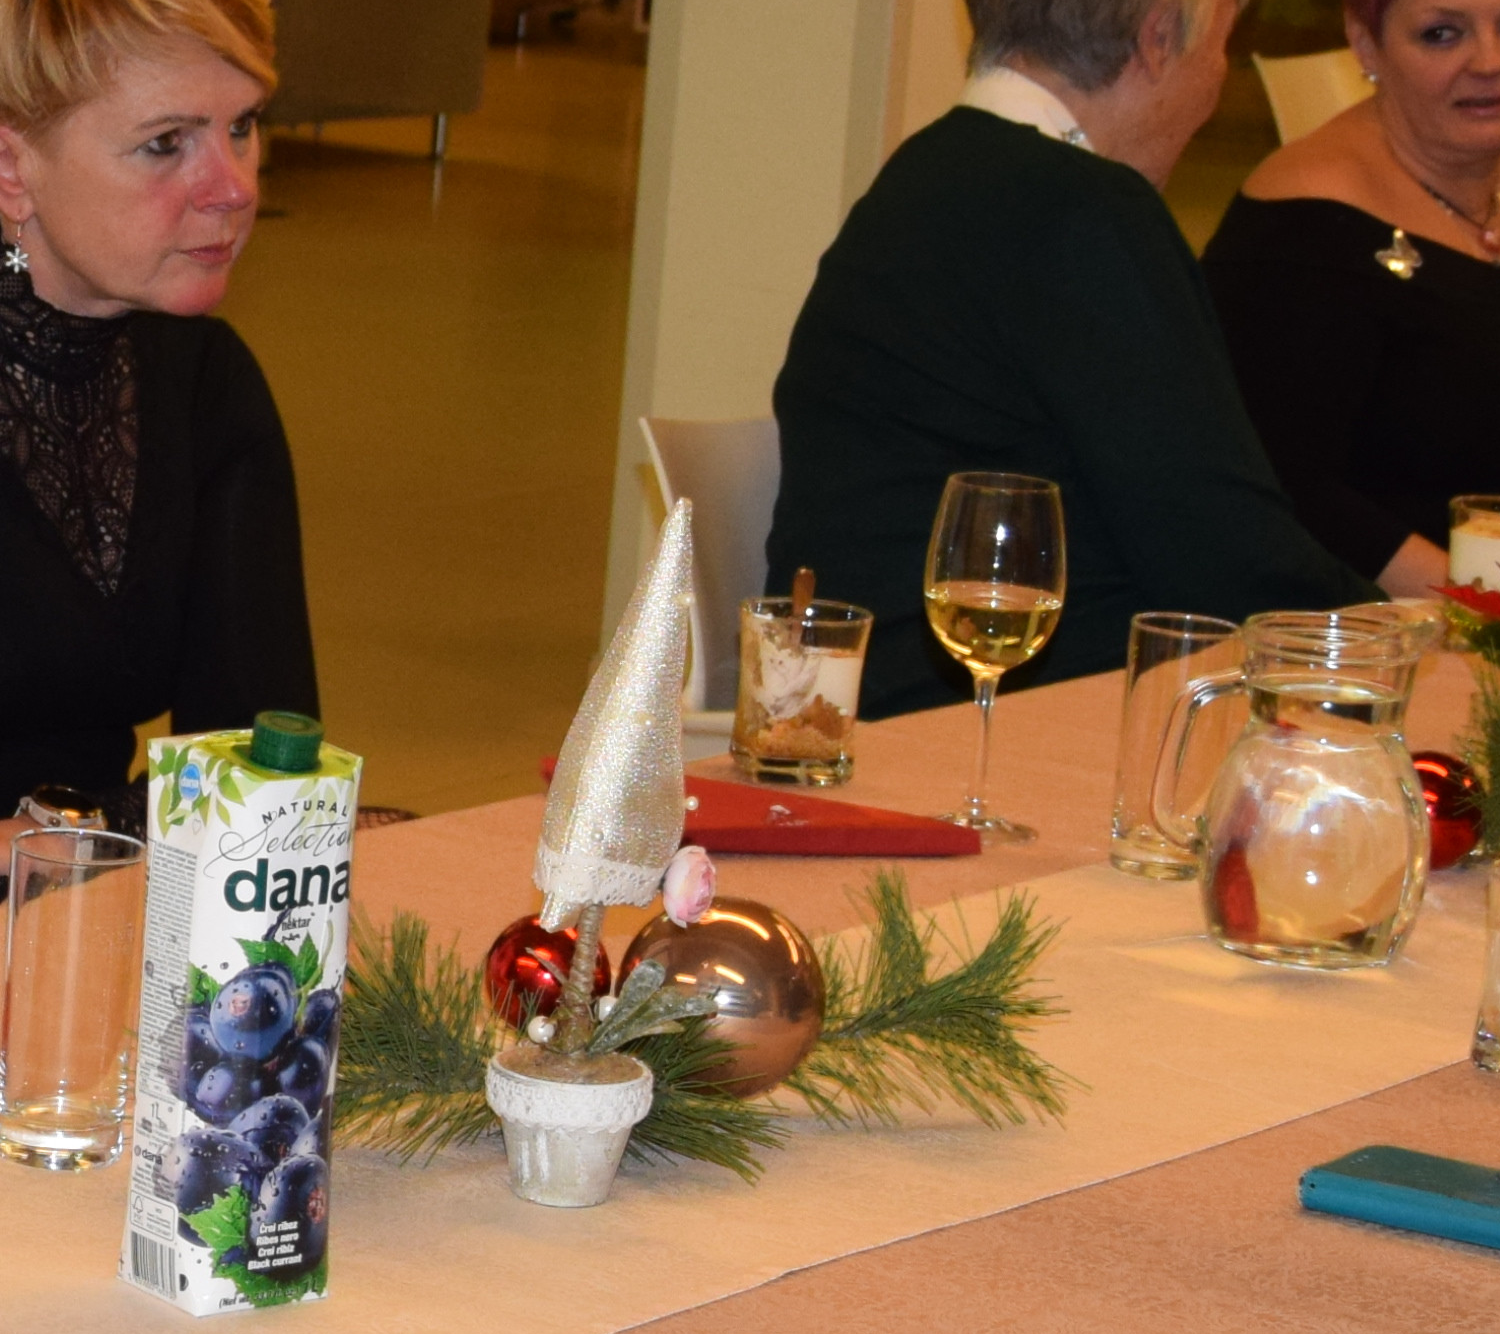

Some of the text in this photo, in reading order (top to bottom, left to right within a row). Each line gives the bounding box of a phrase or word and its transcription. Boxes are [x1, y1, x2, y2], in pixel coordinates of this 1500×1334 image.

[261, 799, 348, 824] NATURAL
[223, 857, 351, 913] dana
[281, 917, 311, 932] nektar
